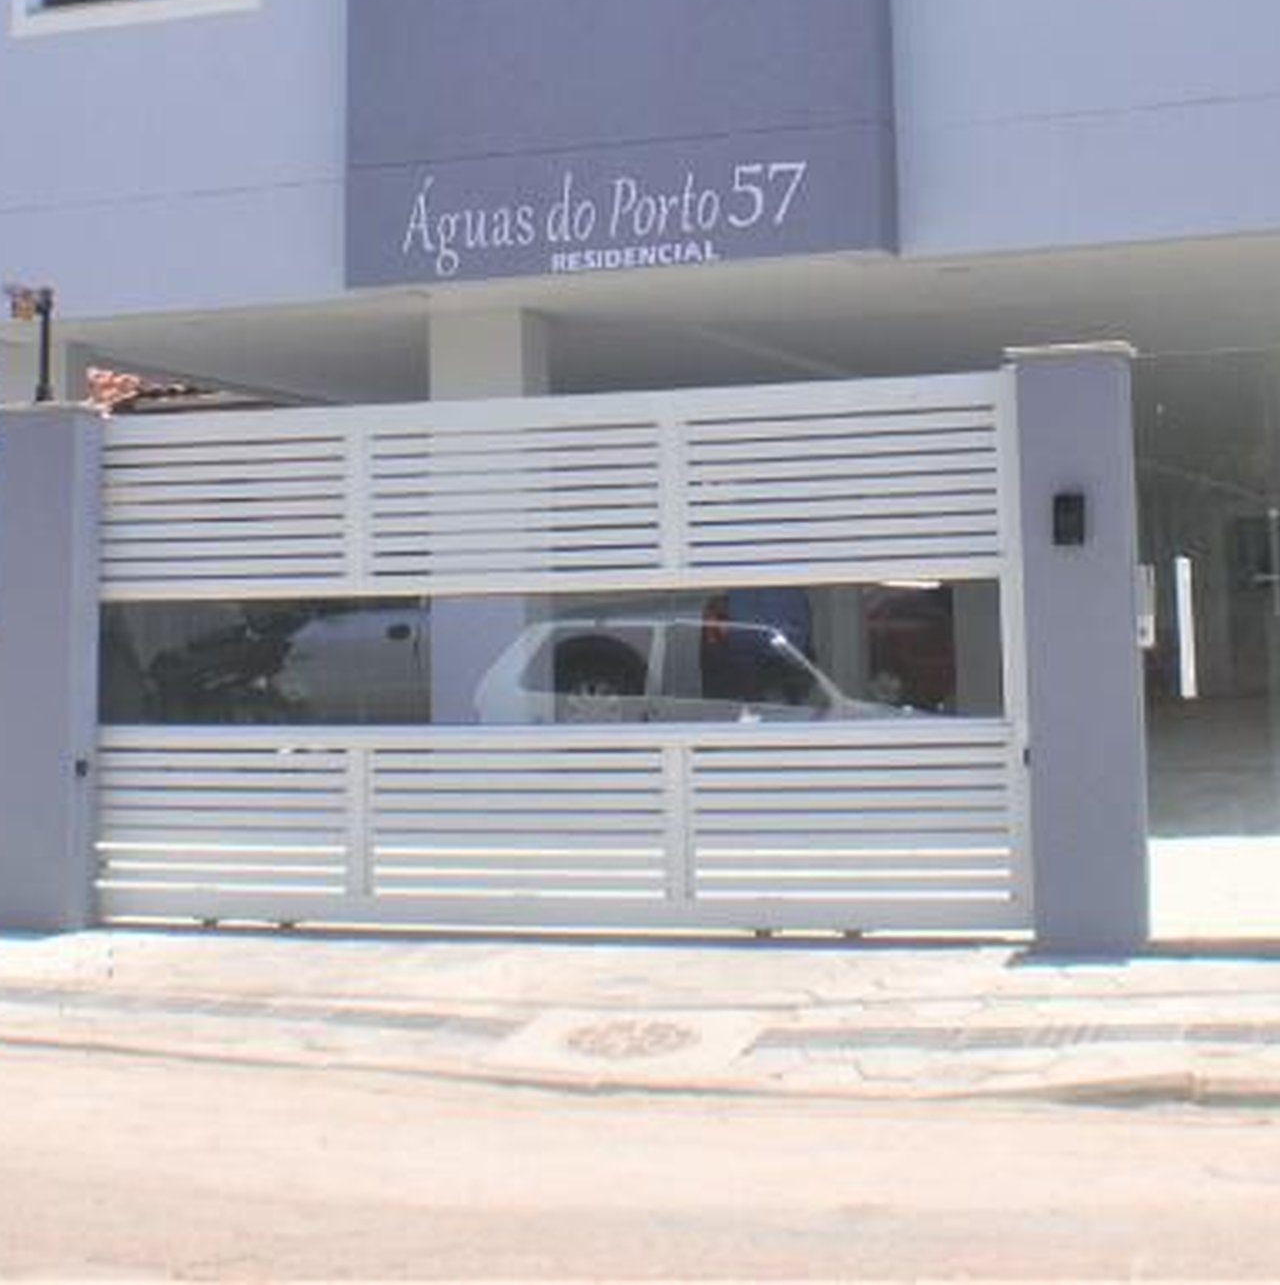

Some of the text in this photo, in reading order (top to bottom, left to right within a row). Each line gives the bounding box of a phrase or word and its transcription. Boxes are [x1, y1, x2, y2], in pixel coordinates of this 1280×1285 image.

[402, 160, 807, 276] Águas do Porto 57
[550, 240, 720, 271] RESIDENCIAL
